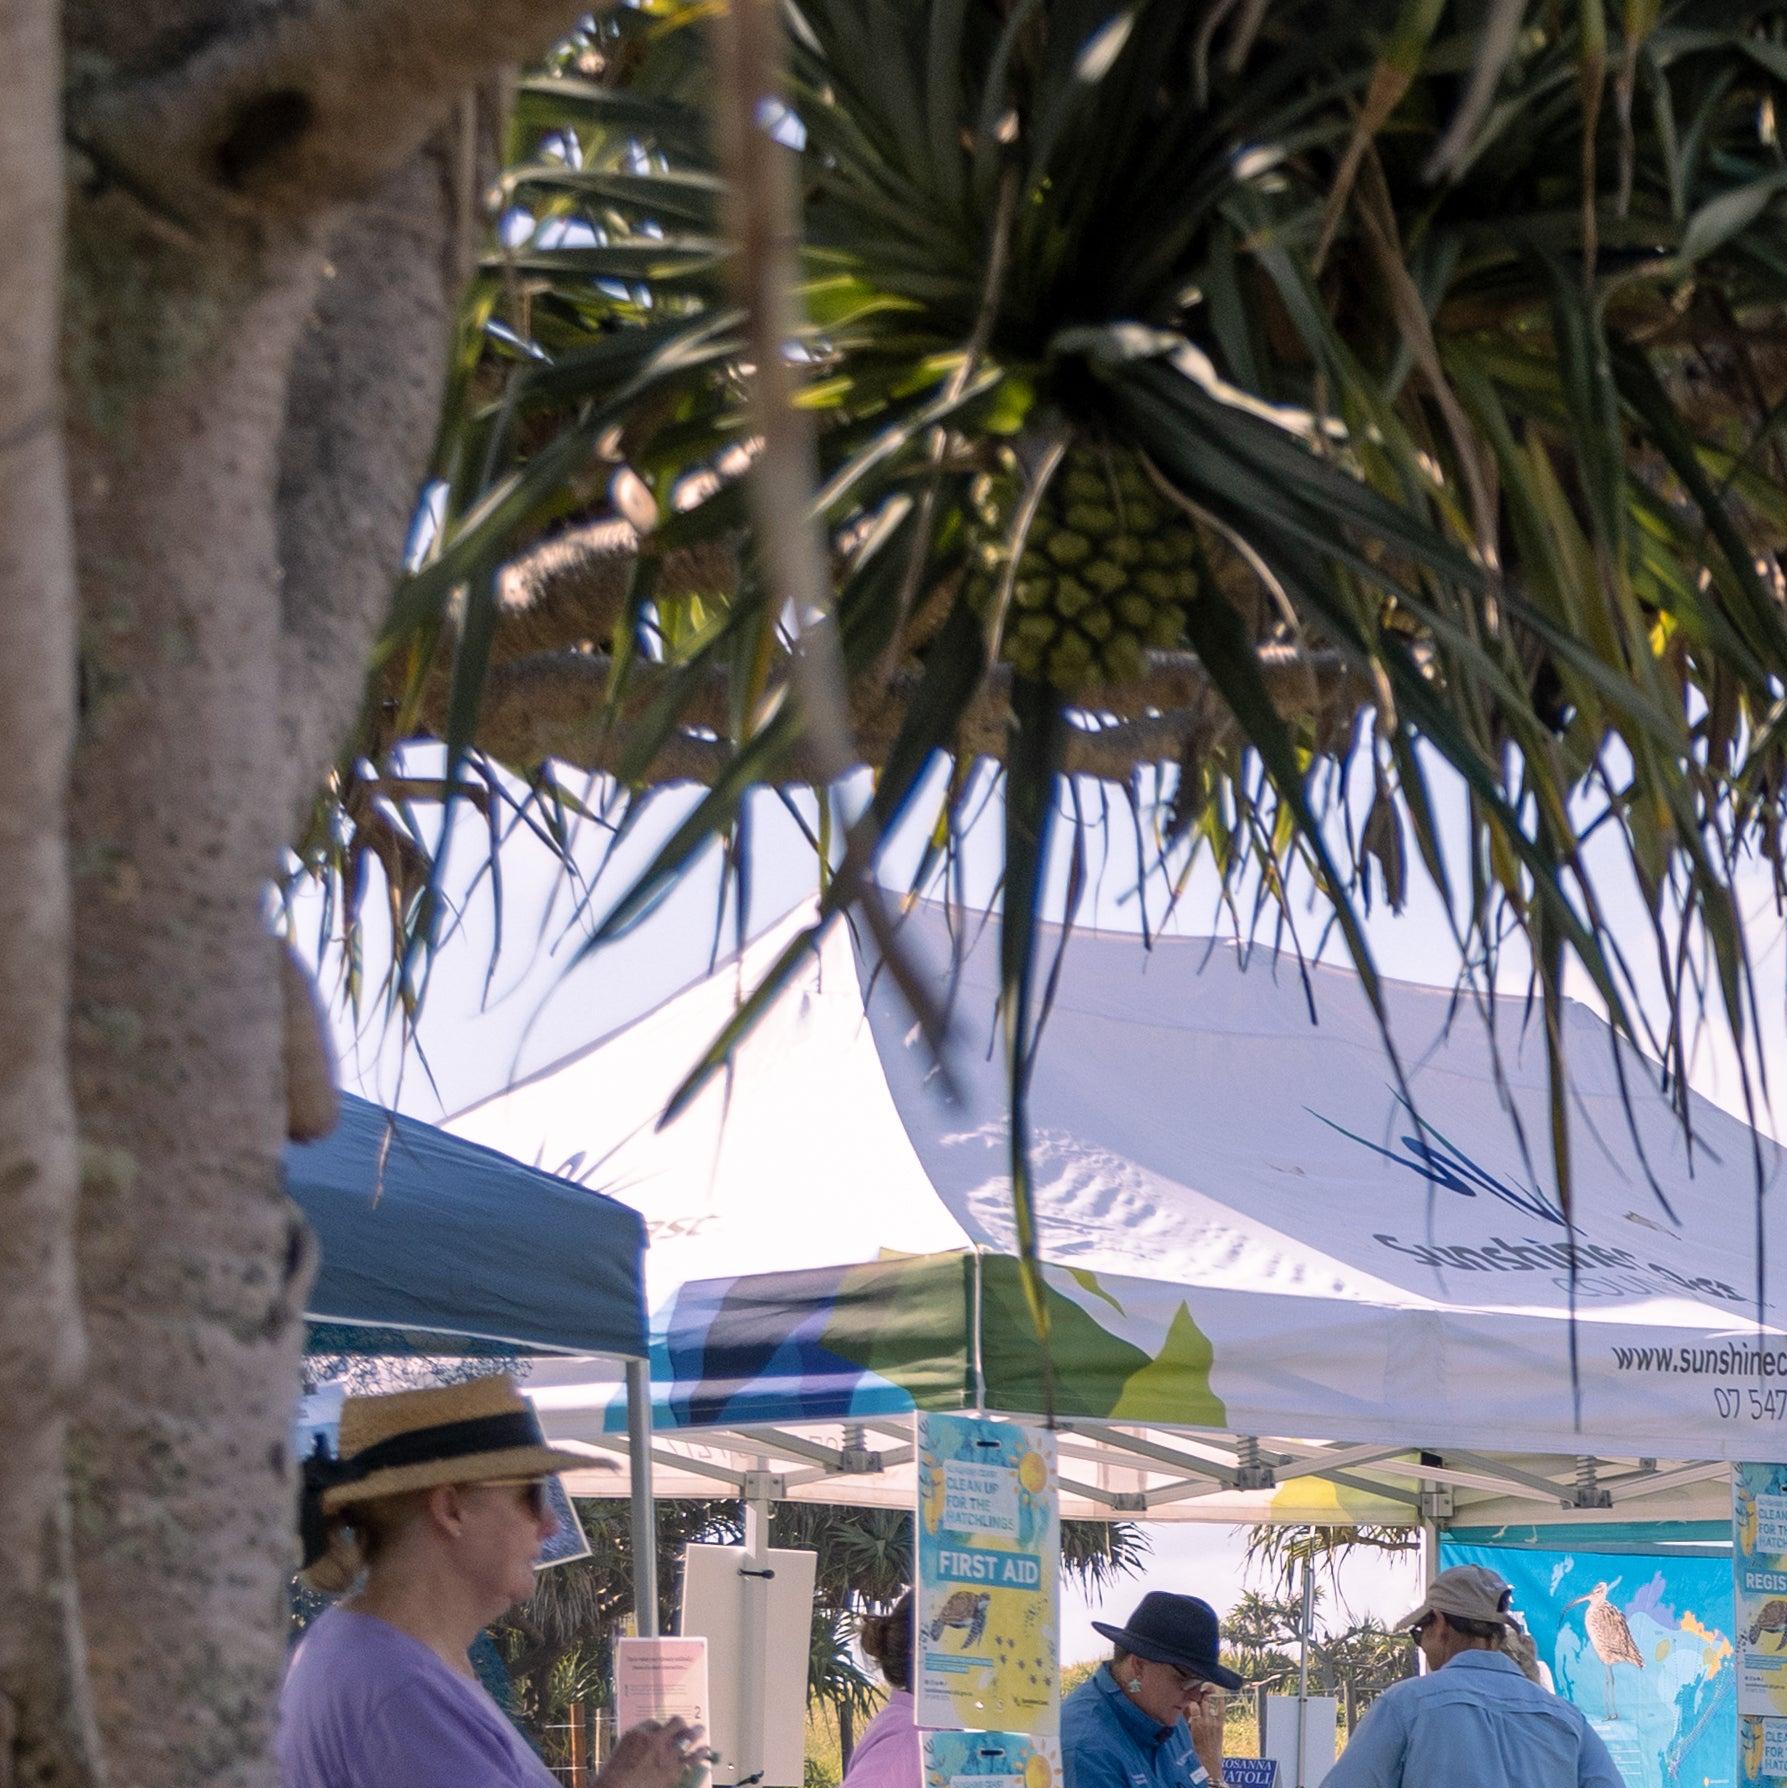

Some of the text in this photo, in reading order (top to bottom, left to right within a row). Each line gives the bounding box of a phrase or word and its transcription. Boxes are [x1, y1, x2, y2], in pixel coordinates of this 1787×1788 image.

[1714, 1387, 1740, 1418] 07
[946, 1476, 999, 1494] CLEAN UP
[946, 1495, 991, 1512] FOR THE
[1758, 1523, 1776, 1534] FOR
[940, 1550, 1039, 1584] FIRST AID
[1765, 1746, 1783, 1759] FOR
